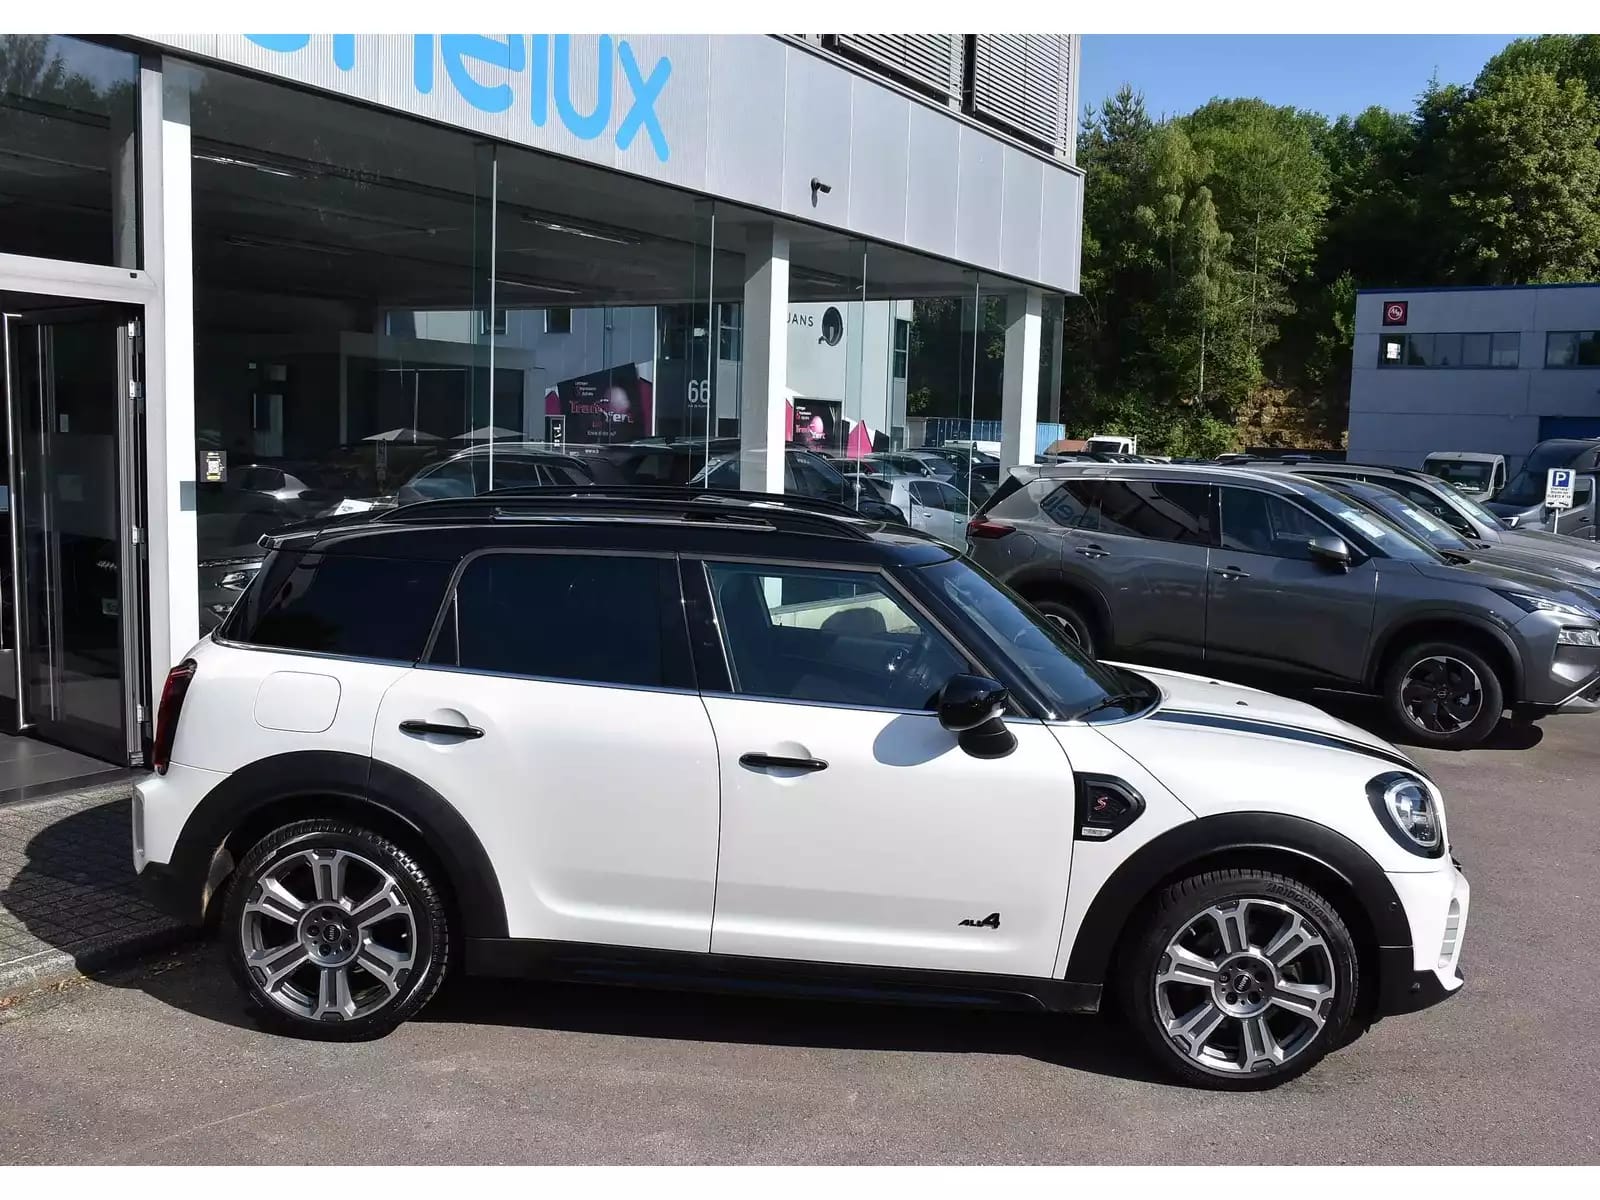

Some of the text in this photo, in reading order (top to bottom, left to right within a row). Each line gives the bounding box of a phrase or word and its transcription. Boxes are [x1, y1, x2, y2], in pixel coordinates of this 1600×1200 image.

[243, 34, 672, 162] elux
[688, 379, 711, 403] 66
[1555, 472, 1566, 485] P
[1093, 796, 1108, 811] S
